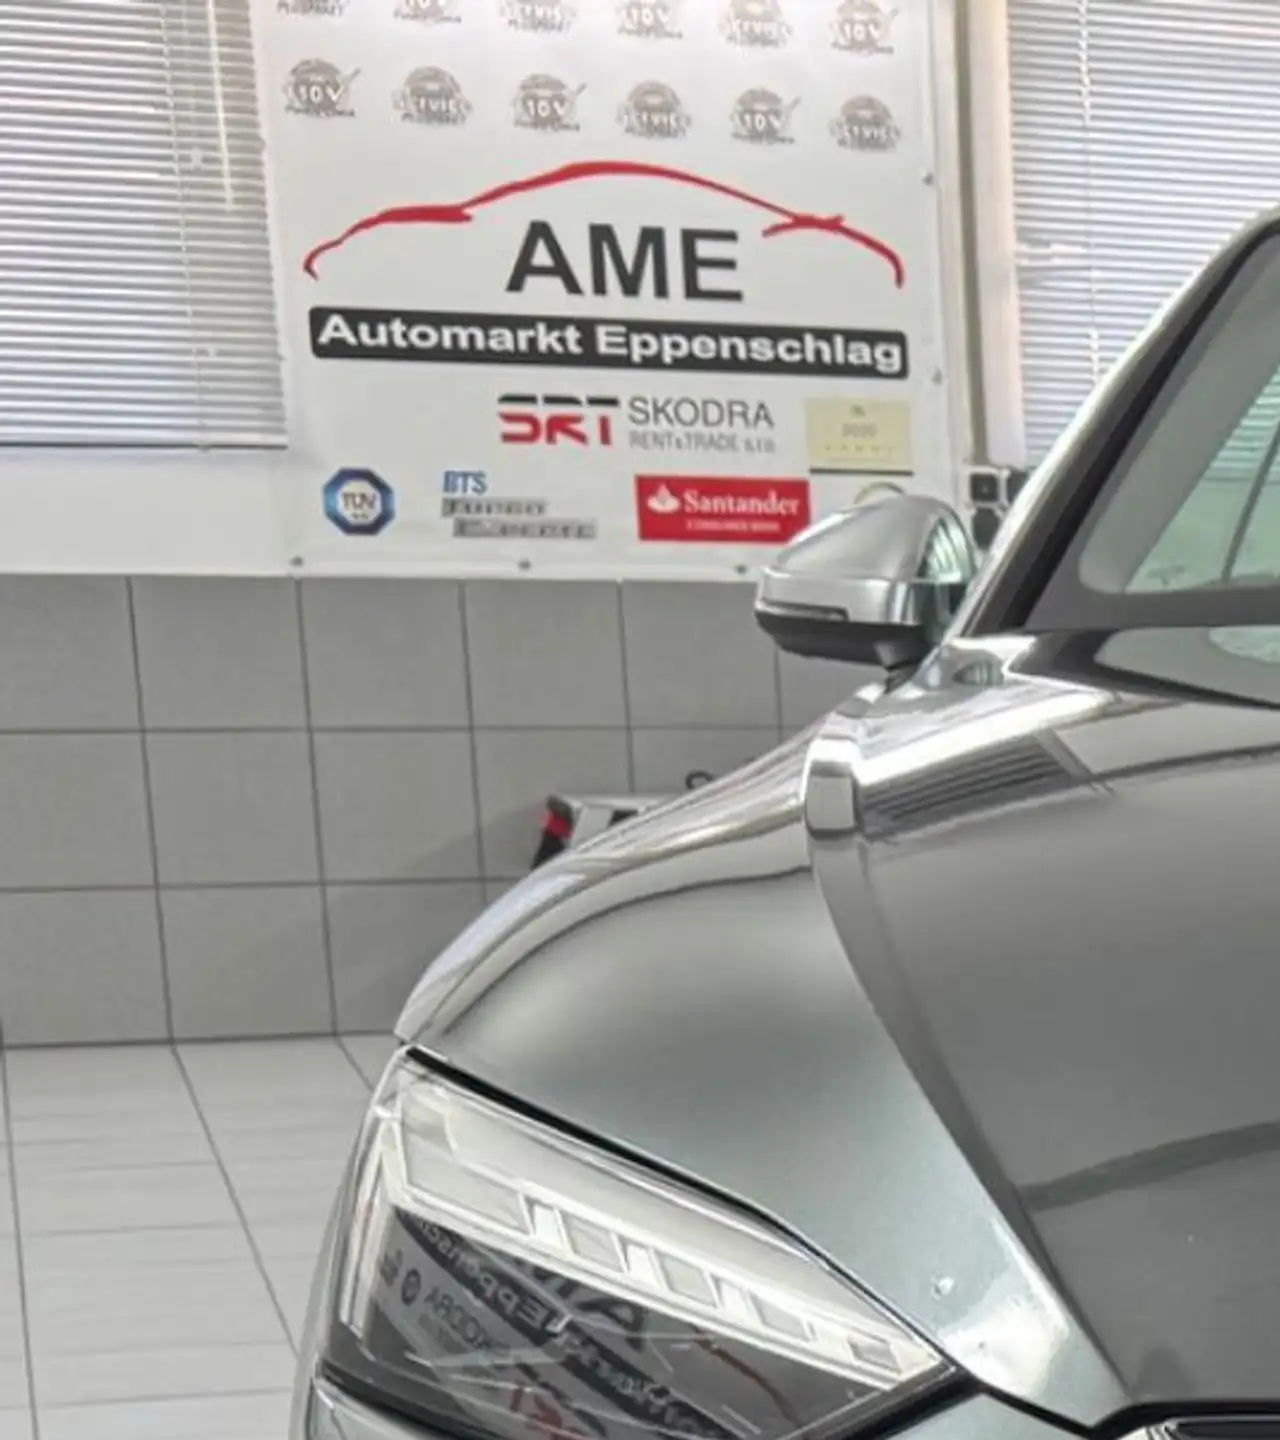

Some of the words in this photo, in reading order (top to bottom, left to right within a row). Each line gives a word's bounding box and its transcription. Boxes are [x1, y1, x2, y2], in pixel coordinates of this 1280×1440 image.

[505, 220, 744, 302] AME
[318, 313, 583, 355] Automarkt
[596, 326, 902, 373] Eppenschlag
[628, 395, 775, 429] SKODRA
[683, 488, 800, 516] Santander
